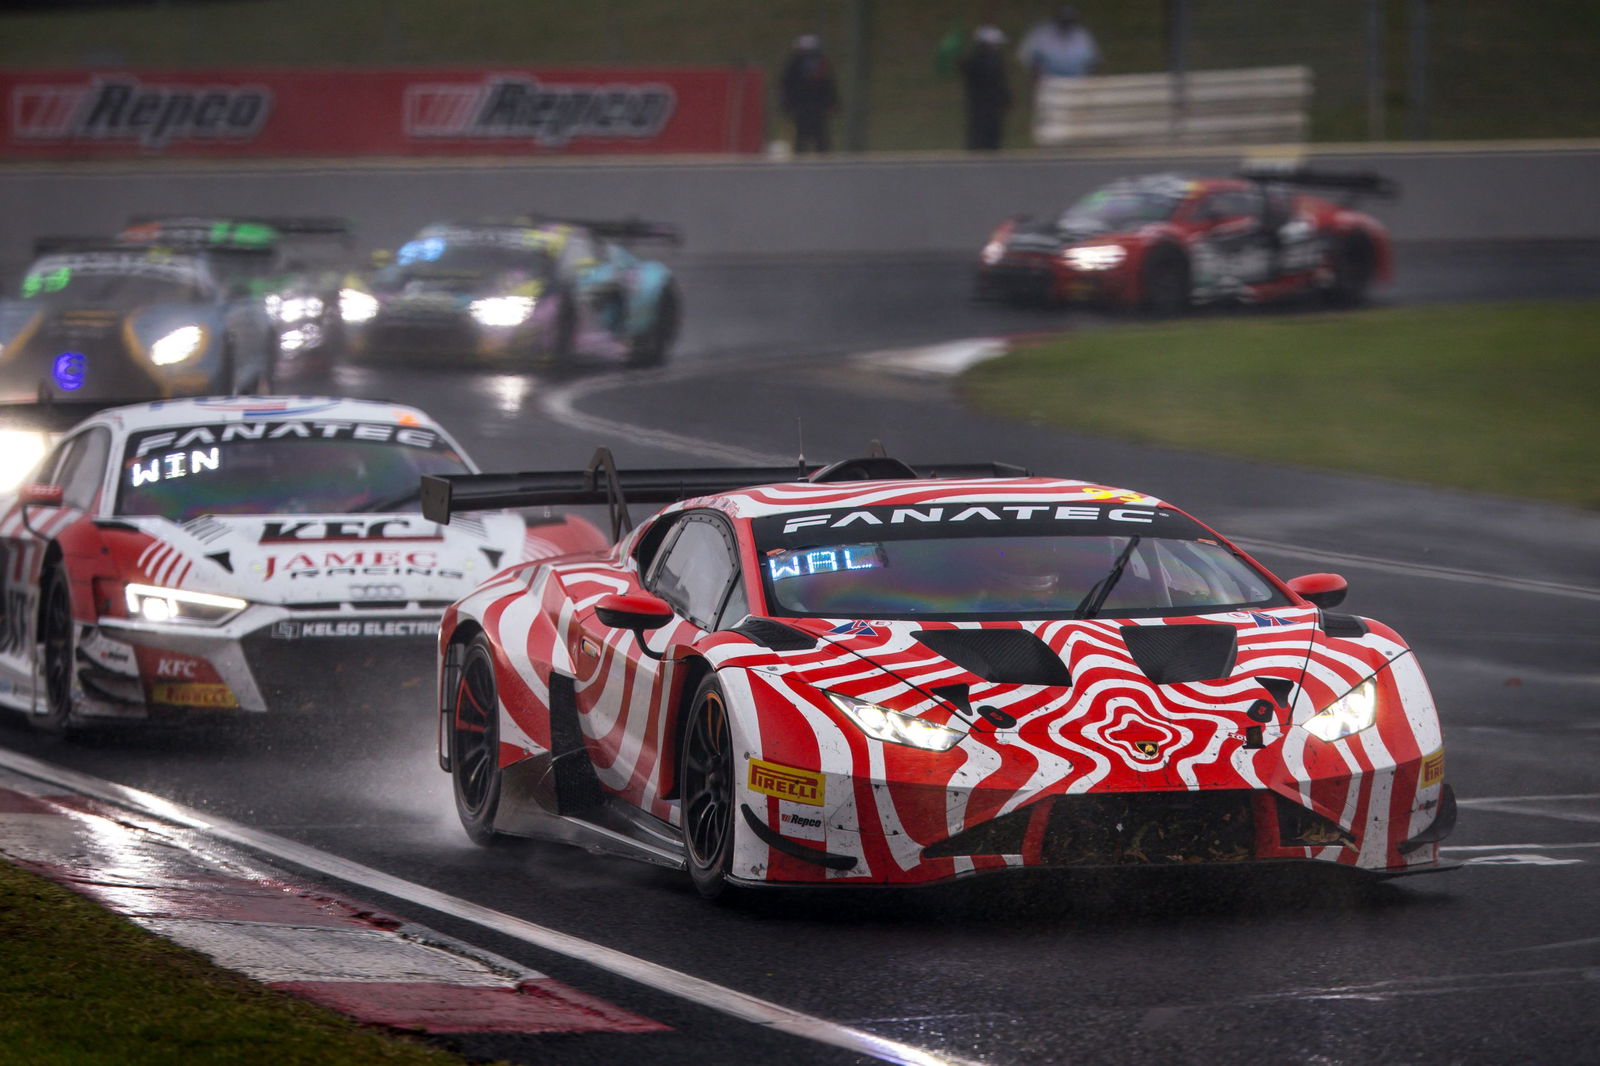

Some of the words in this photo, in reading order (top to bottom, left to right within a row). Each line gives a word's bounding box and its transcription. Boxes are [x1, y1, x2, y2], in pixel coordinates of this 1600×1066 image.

[86, 80, 266, 142] Repco
[473, 79, 672, 142] Repco
[136, 423, 437, 457] FANATEC
[132, 448, 220, 487] WIN
[261, 518, 411, 540] KFC
[782, 506, 1155, 534] FANATEC
[264, 552, 438, 581] JAMEC
[291, 567, 464, 580] RACING
[769, 549, 873, 581] WAL
[303, 622, 360, 637] KELSO
[157, 658, 197, 678] KFC
[751, 764, 818, 799] PIRELLI
[791, 814, 822, 828] Repco
